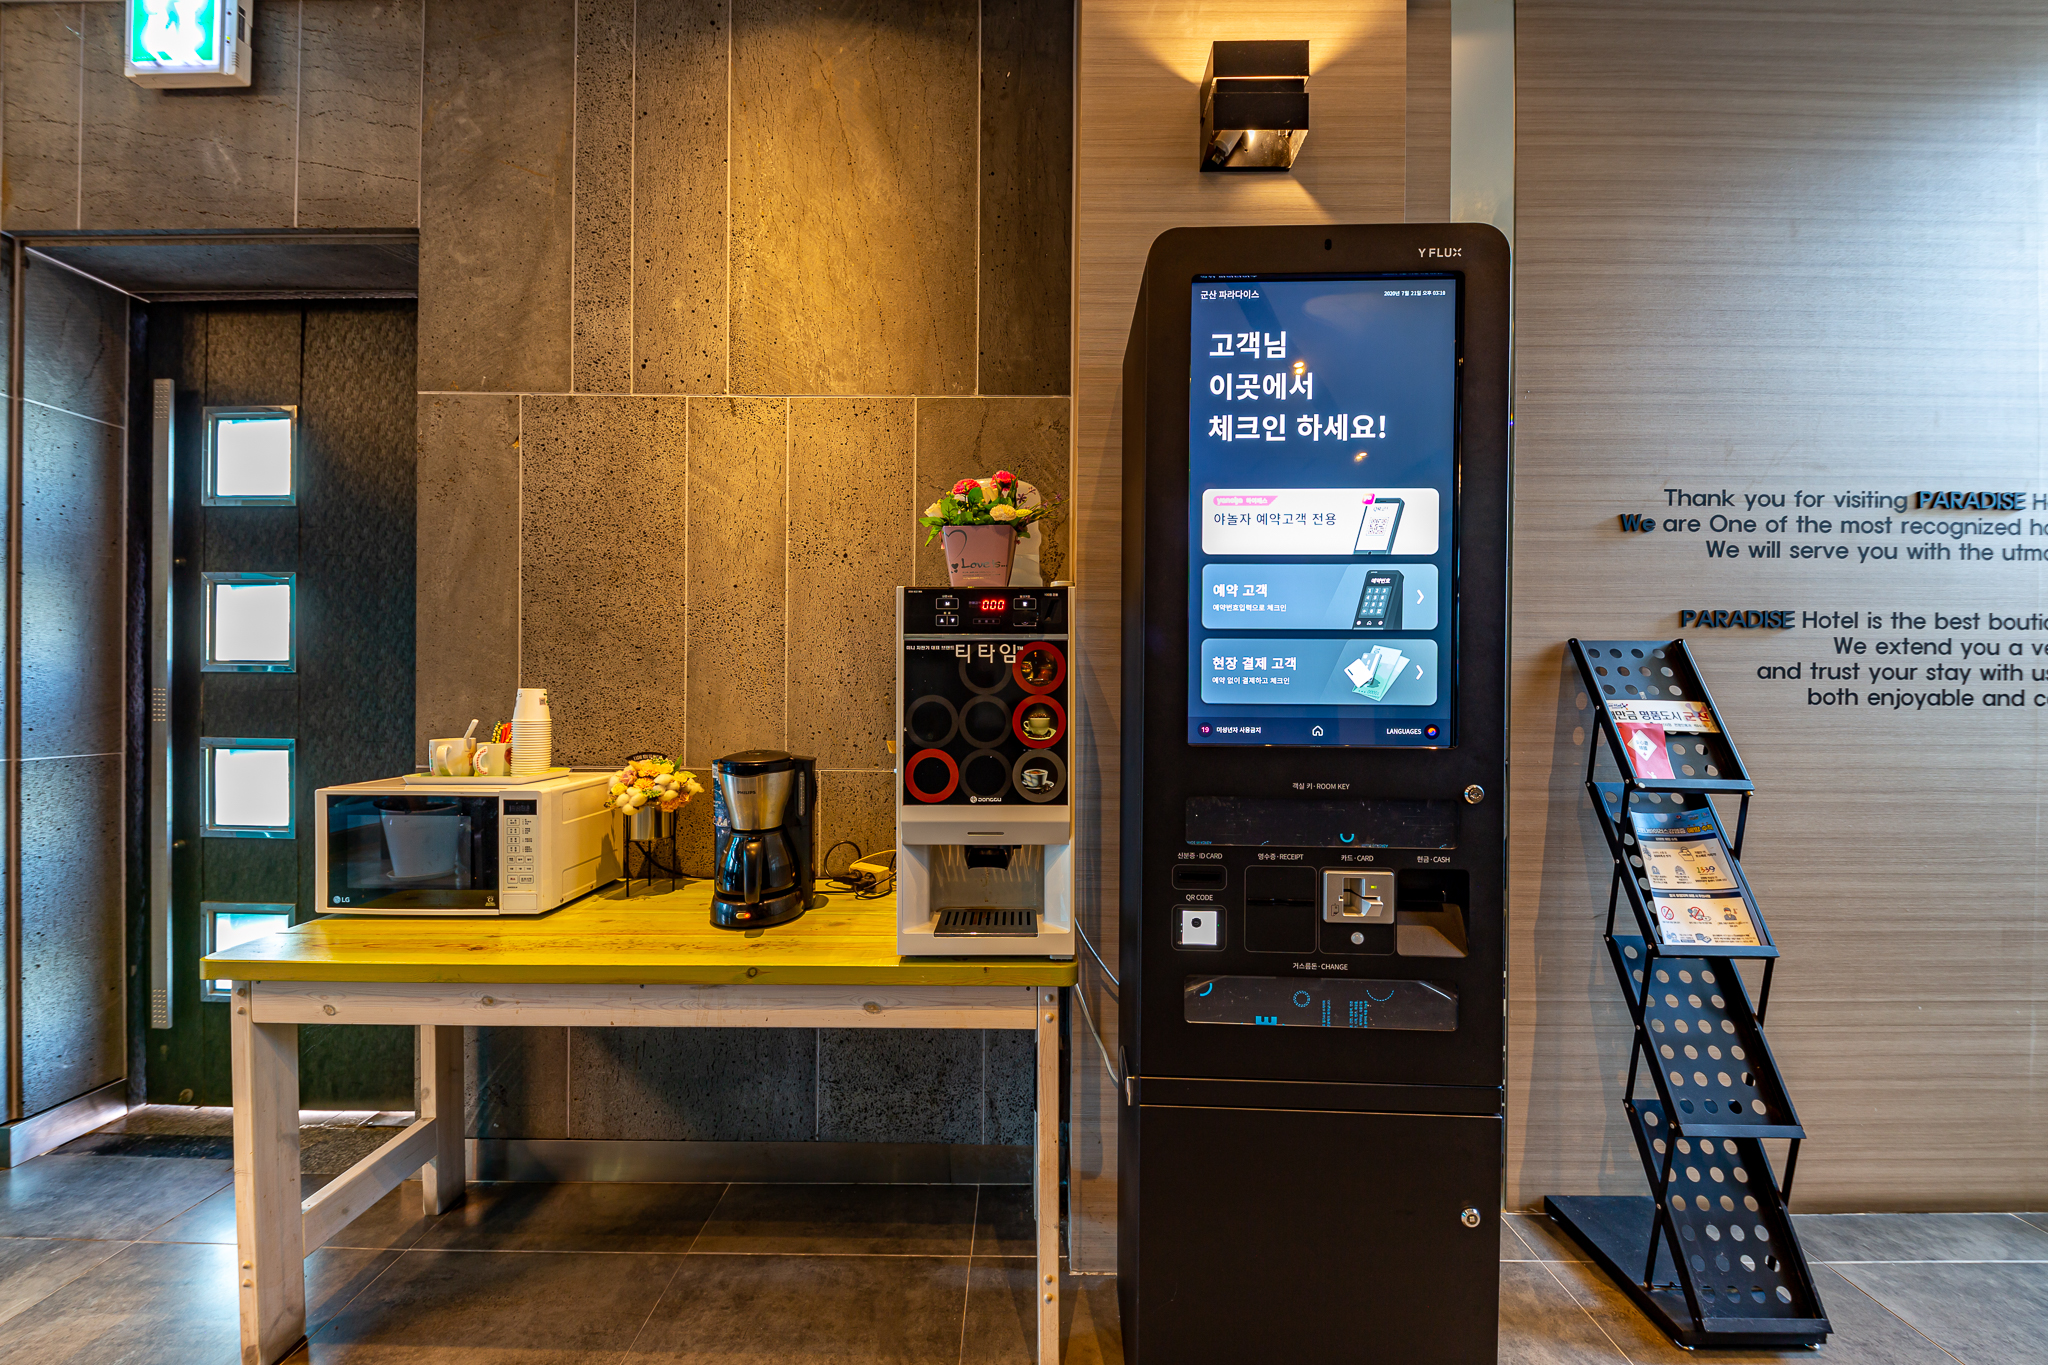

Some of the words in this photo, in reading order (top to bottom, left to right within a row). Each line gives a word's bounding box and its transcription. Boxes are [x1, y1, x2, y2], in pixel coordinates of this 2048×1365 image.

[1200, 290, 1216, 300] 군산
[1218, 290, 1260, 300] 파라다이스
[1209, 330, 1287, 359] 고객님
[1210, 372, 1313, 400] 이곳에서
[1208, 414, 1286, 442] 체크인
[1296, 414, 1386, 442] 하세요!
[1664, 489, 1736, 508] Thank
[1745, 494, 1786, 511] you
[1793, 490, 1826, 508] for
[1833, 490, 1908, 514] visiting
[1917, 490, 2027, 510] PARADISE
[2033, 493, 2048, 511] H
[1214, 512, 1252, 526] 야놀자
[1256, 512, 1306, 526] 예약고객
[1312, 512, 1337, 526] 전용
[1620, 514, 1656, 532] We
[1663, 518, 1701, 532] are
[1710, 514, 1757, 533] One
[1766, 514, 1788, 533] of
[1796, 514, 1832, 534] the
[1840, 516, 1893, 534] most
[1901, 518, 2021, 540] recognized
[1706, 540, 1740, 558] We
[1748, 540, 1781, 559] will
[1789, 544, 1849, 560] serve
[1858, 544, 1898, 564] you
[1907, 542, 1950, 560] with
[1959, 543, 1994, 561] the
[961, 558, 990, 568] Love
[1212, 584, 1238, 598] 예약
[1242, 584, 1268, 598] 고객
[982, 599, 1005, 610] 000
[1212, 604, 1265, 612] 예약번호입력으로
[1267, 603, 1287, 612] 체크인
[1679, 610, 1796, 629] PARADISE
[1802, 610, 1859, 629] Hotel
[1867, 612, 1882, 630] is
[1891, 612, 1926, 630] the
[1934, 612, 1980, 630] best
[1834, 636, 1867, 655] We
[1875, 638, 1952, 656] extend
[1960, 642, 2000, 659] you
[2009, 642, 2023, 656] a
[1212, 656, 1238, 671] 현장
[1242, 656, 1267, 671] 결제
[1271, 656, 1297, 671] 고객
[1757, 662, 1801, 680] and
[1809, 662, 1860, 680] trust
[1868, 666, 1918, 685] your
[1926, 663, 1971, 685] stay
[1980, 664, 2023, 681] with
[1212, 677, 1225, 685] 예약
[1227, 677, 1240, 685] 없이
[1242, 677, 1268, 685] 결제하고
[1270, 677, 1290, 685] 체크인
[1808, 688, 1859, 706] both
[1867, 688, 1974, 711] enjoyable
[1982, 690, 2025, 707] and
[2034, 693, 2048, 707] c
[1639, 710, 1682, 722] 명품도시
